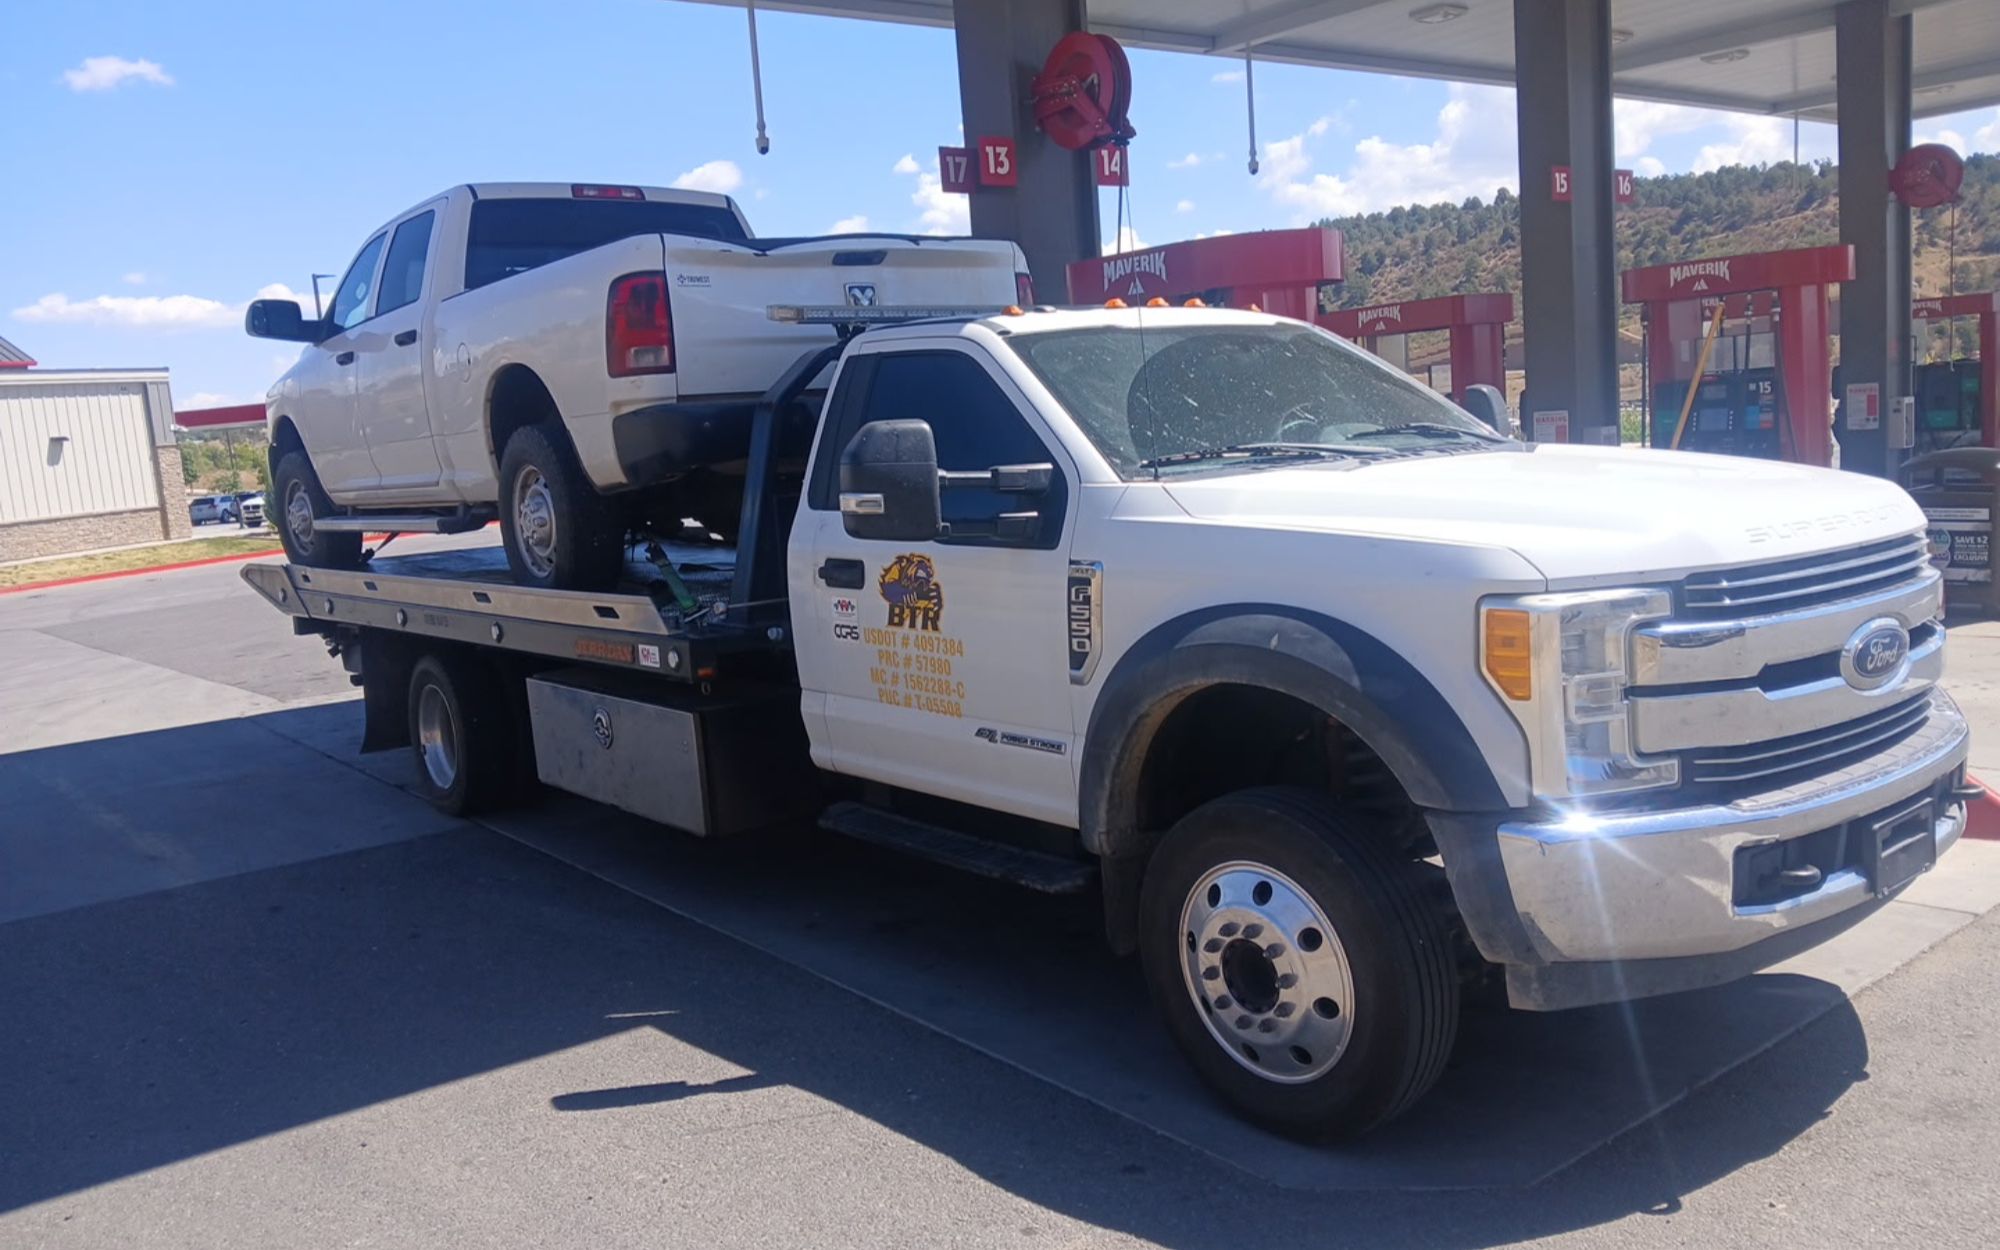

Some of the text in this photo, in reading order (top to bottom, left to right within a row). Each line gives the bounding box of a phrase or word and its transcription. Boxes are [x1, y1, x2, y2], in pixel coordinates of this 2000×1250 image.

[946, 155, 968, 184] 17
[985, 145, 1010, 175] 13
[1101, 149, 1122, 176] 14
[1555, 172, 1568, 193] 15
[1618, 175, 1631, 195] 16
[1103, 251, 1168, 292] MAVERIK
[1670, 260, 1730, 288] MAVERIK
[1358, 304, 1401, 328] MAVERIK
[1759, 382, 1771, 394] 15
[1954, 535, 1975, 545] SAVE
[887, 603, 941, 632] BTR
[1071, 585, 1091, 653] F550
[863, 627, 964, 657] USDOT # 4097384
[1867, 637, 1899, 671] Ford
[870, 667, 887, 686] MC
[891, 672, 900, 687] #
[903, 654, 913, 670] #
[915, 655, 952, 676] 57980
[903, 692, 913, 709] #
